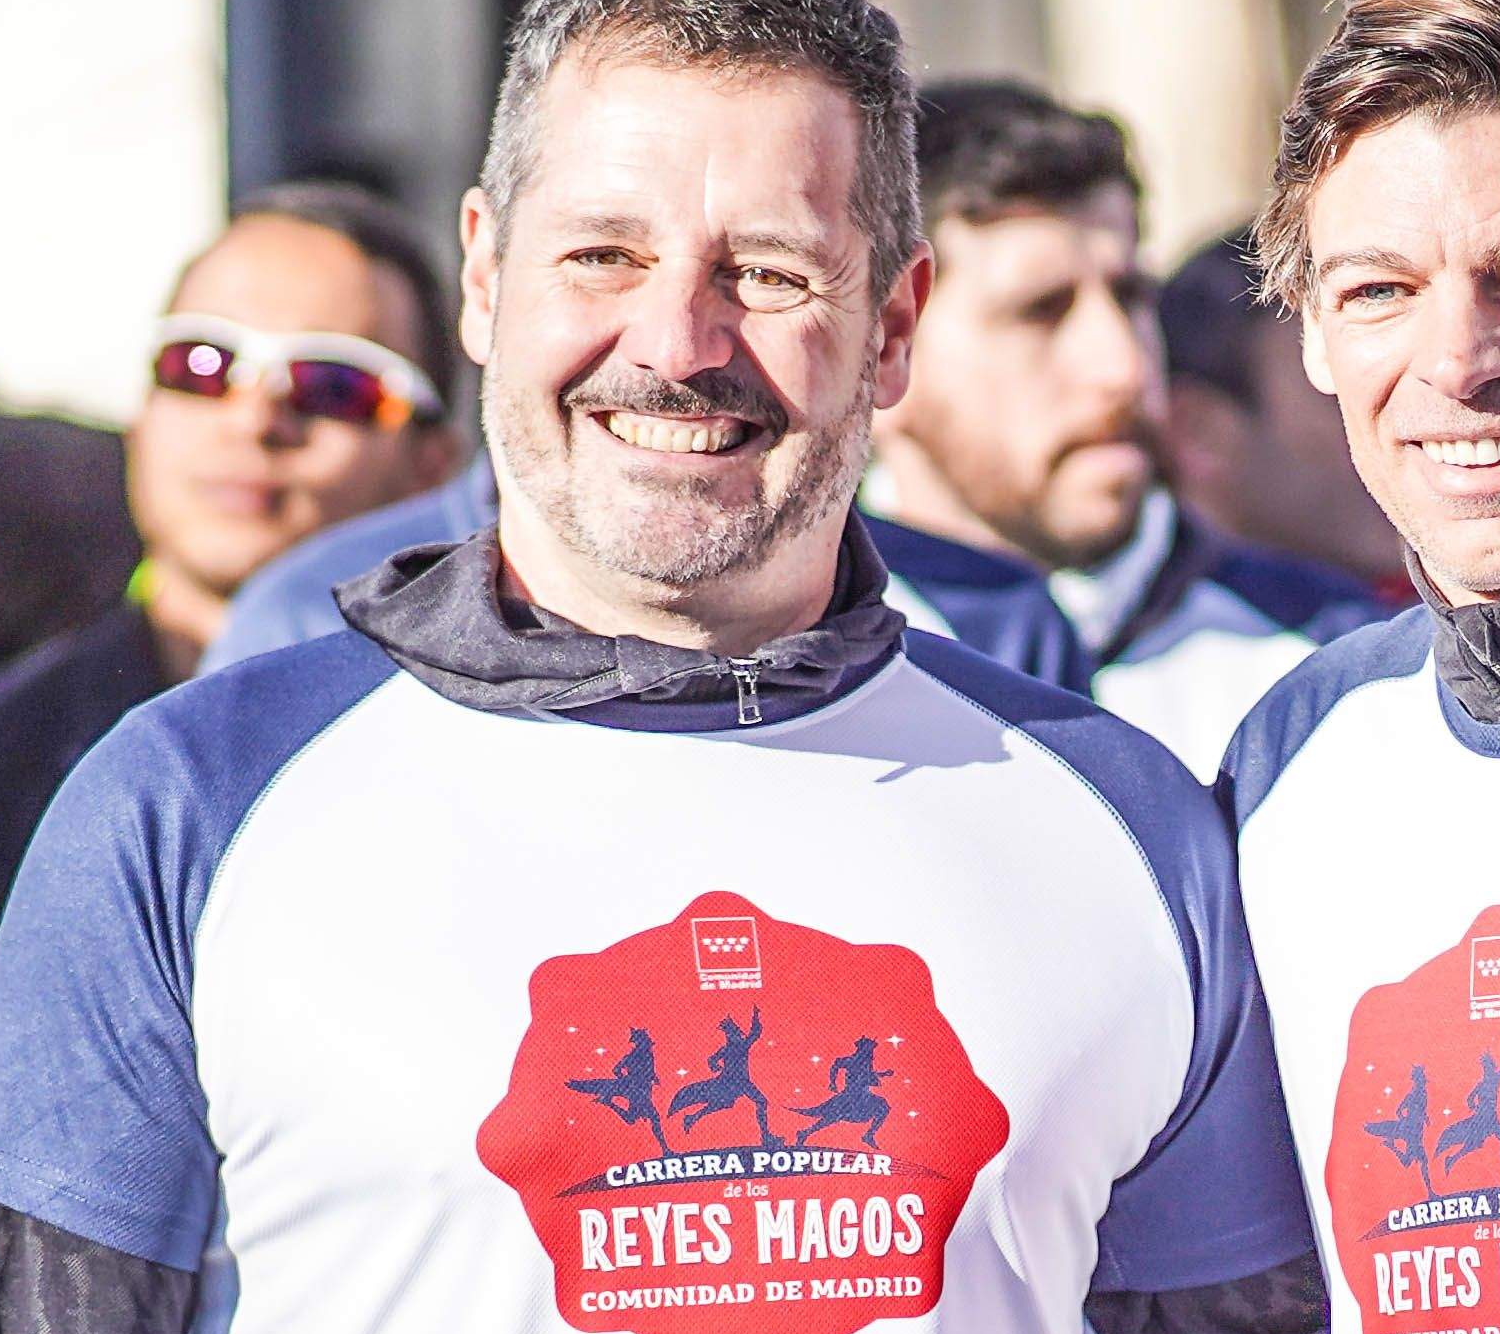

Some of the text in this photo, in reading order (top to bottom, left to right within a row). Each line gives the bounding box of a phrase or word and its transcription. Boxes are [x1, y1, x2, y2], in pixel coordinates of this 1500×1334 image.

[605, 1150, 893, 1187] CARRERA POPULAR
[723, 1181, 769, 1198] de los
[1387, 1194, 1493, 1232] CARRERA
[577, 1193, 925, 1272] REYES MAGOS
[1473, 1225, 1490, 1241] de
[580, 1276, 924, 1312] COMUNIDAD DE MADRID
[1373, 1245, 1482, 1316] REYES
